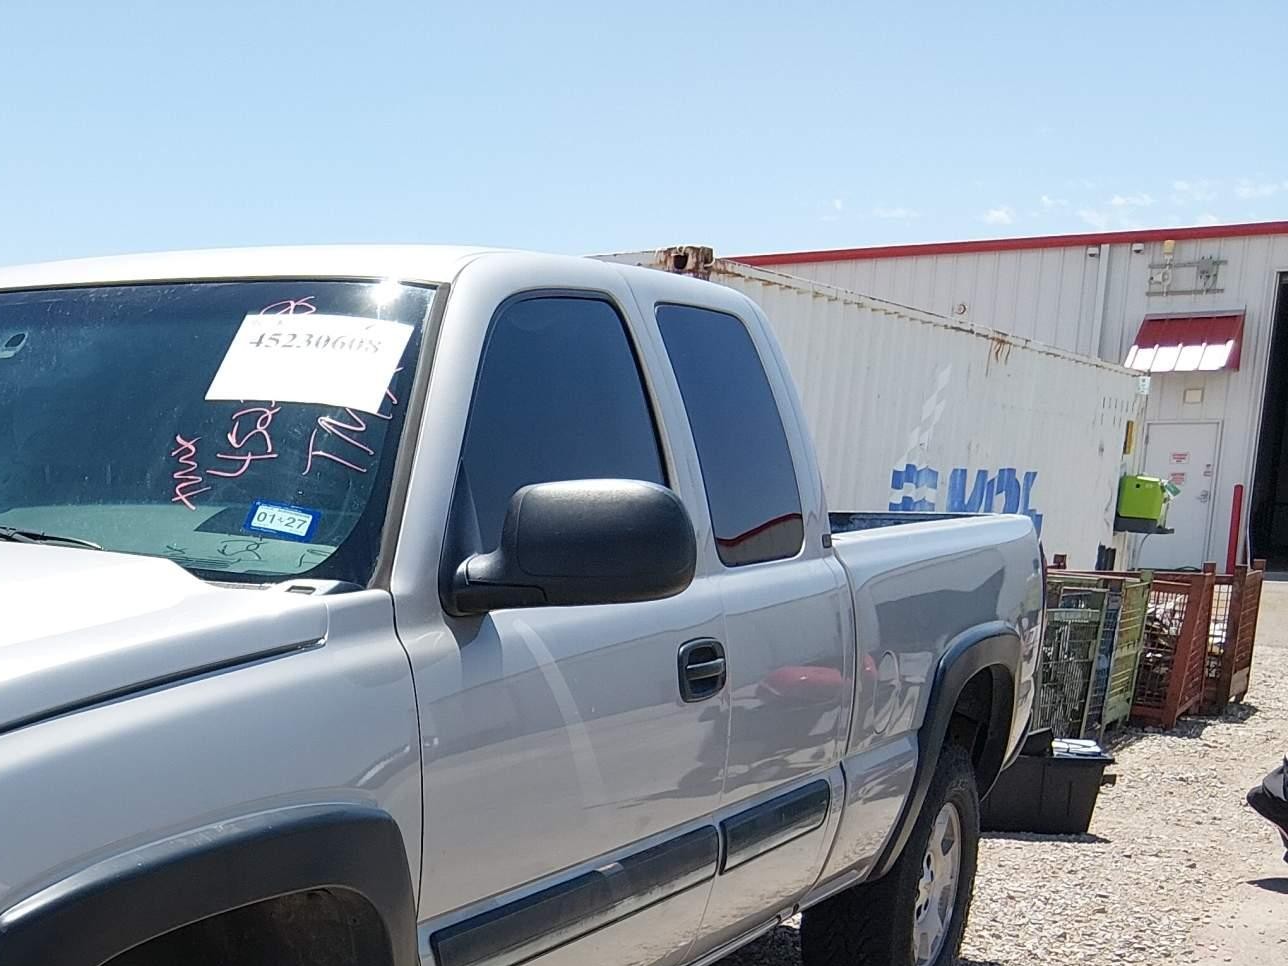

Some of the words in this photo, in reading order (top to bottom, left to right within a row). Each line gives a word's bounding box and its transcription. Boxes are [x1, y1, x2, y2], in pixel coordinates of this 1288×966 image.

[249, 331, 382, 354] 45230608
[256, 511, 276, 525] 01
[284, 516, 308, 530] 27
